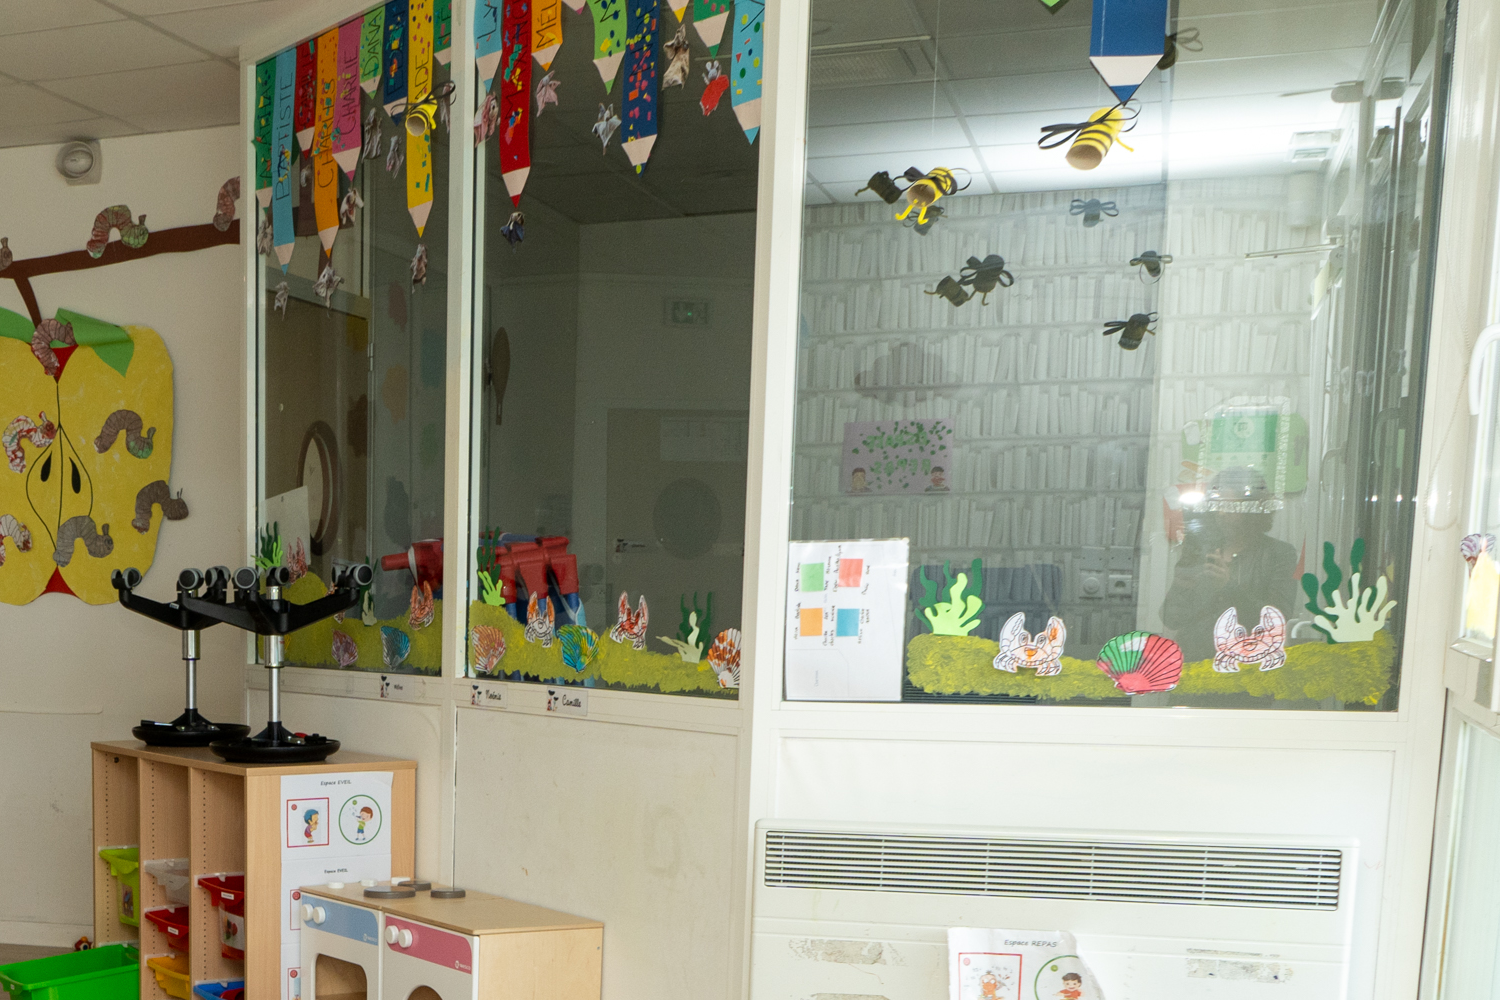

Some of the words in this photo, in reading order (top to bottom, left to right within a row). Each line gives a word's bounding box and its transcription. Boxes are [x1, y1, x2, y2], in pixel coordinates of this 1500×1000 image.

[362, 9, 383, 76] DANA
[336, 46, 358, 136] CHARLIE
[562, 694, 581, 708] Camille
[1004, 939, 1029, 947] Espace
[1031, 940, 1057, 948] REPAS
